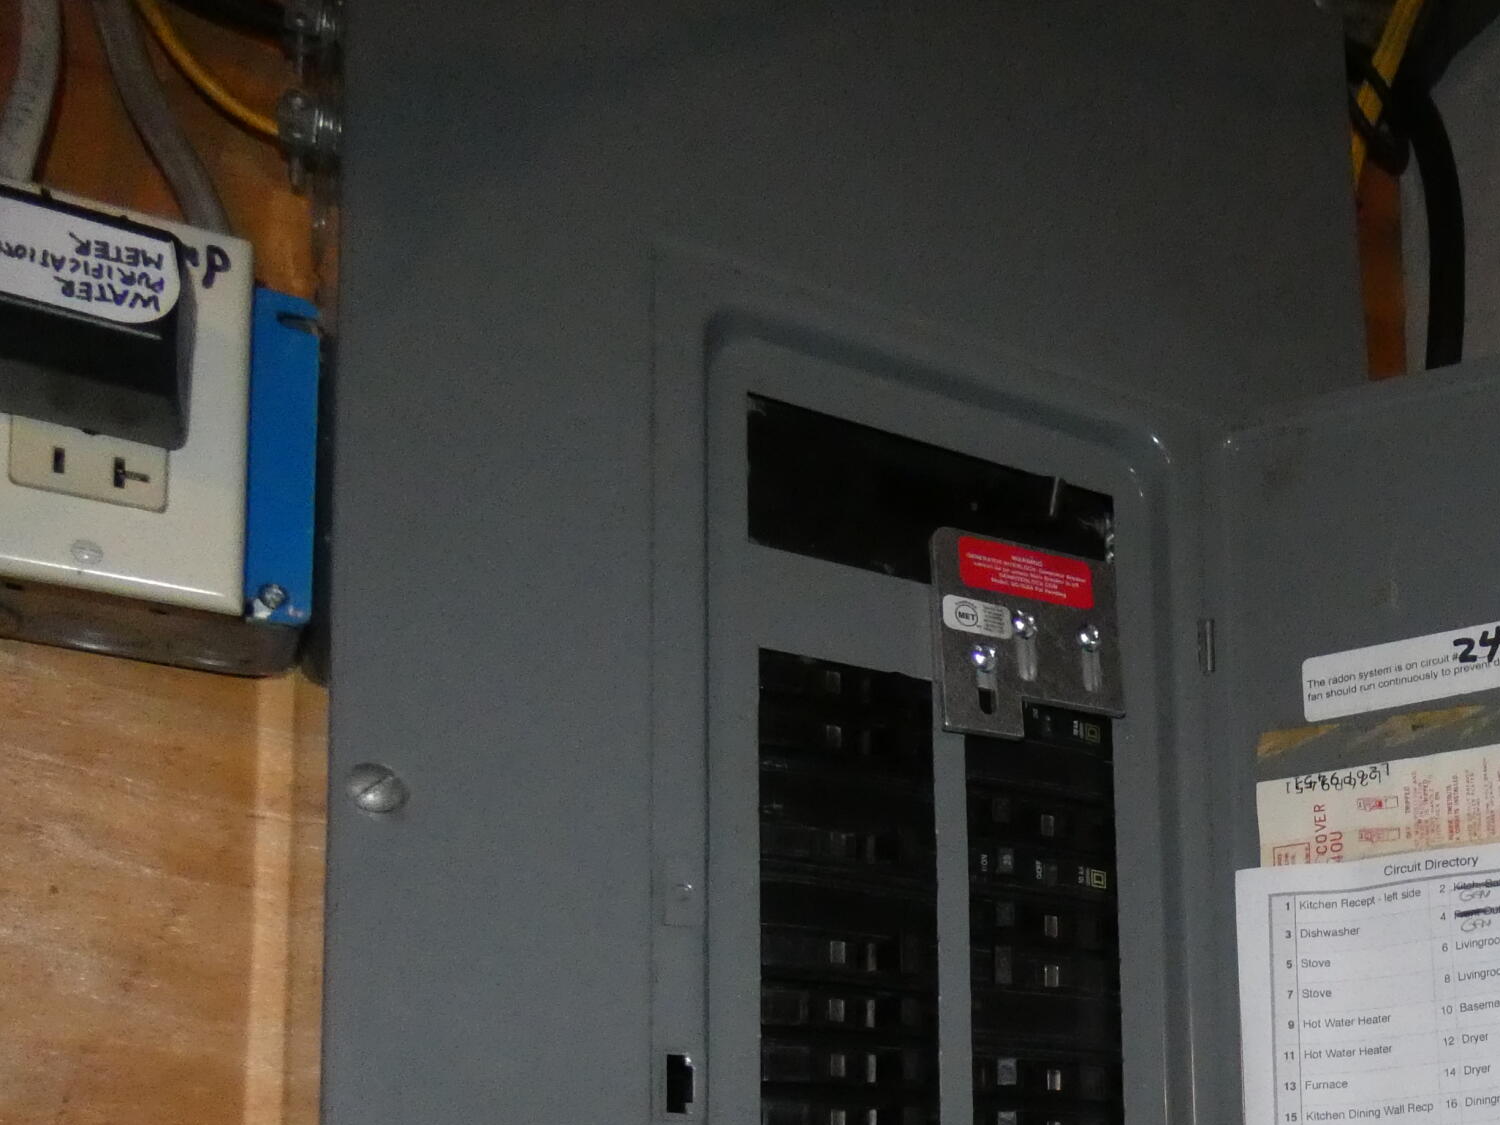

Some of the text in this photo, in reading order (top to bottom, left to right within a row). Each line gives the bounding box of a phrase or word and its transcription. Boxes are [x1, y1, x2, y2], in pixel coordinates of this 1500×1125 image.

[68, 231, 164, 270] METER
[53, 275, 161, 312] WATER
[958, 611, 976, 621] MET
[1307, 654, 1449, 689] The radon system is on circuit
[1307, 691, 1323, 702] fan
[1326, 685, 1356, 698] should
[1359, 682, 1375, 693] run
[1378, 670, 1439, 689] continuously
[1441, 668, 1450, 677] to
[1454, 660, 1491, 676] prevent
[1313, 804, 1328, 855] COVER
[1384, 855, 1479, 876] Circuit Directory
[1440, 885, 1446, 893] 2
[1286, 889, 1421, 910] 1 Kitchen Recept left side
[1440, 913, 1446, 921] 4
[1285, 927, 1360, 939] 3 Dishwasher
[1442, 943, 1448, 952] 6
[1286, 959, 1331, 969] 5 Stove
[1444, 975, 1450, 983] 8
[1288, 990, 1332, 999] 7 Stove
[1441, 1006, 1453, 1015] 10
[1288, 1014, 1391, 1029] 9 Hot Water Heater
[1443, 1032, 1489, 1046] 12 Dryer
[1284, 1045, 1392, 1060] 11 Hot Water Heater
[1445, 1064, 1491, 1077] 14 Dryer
[1285, 1080, 1348, 1091] 13 Furnace
[1446, 1099, 1457, 1108] 16
[1285, 1102, 1434, 1122] 15 Kitchen Dining Wall Recp
